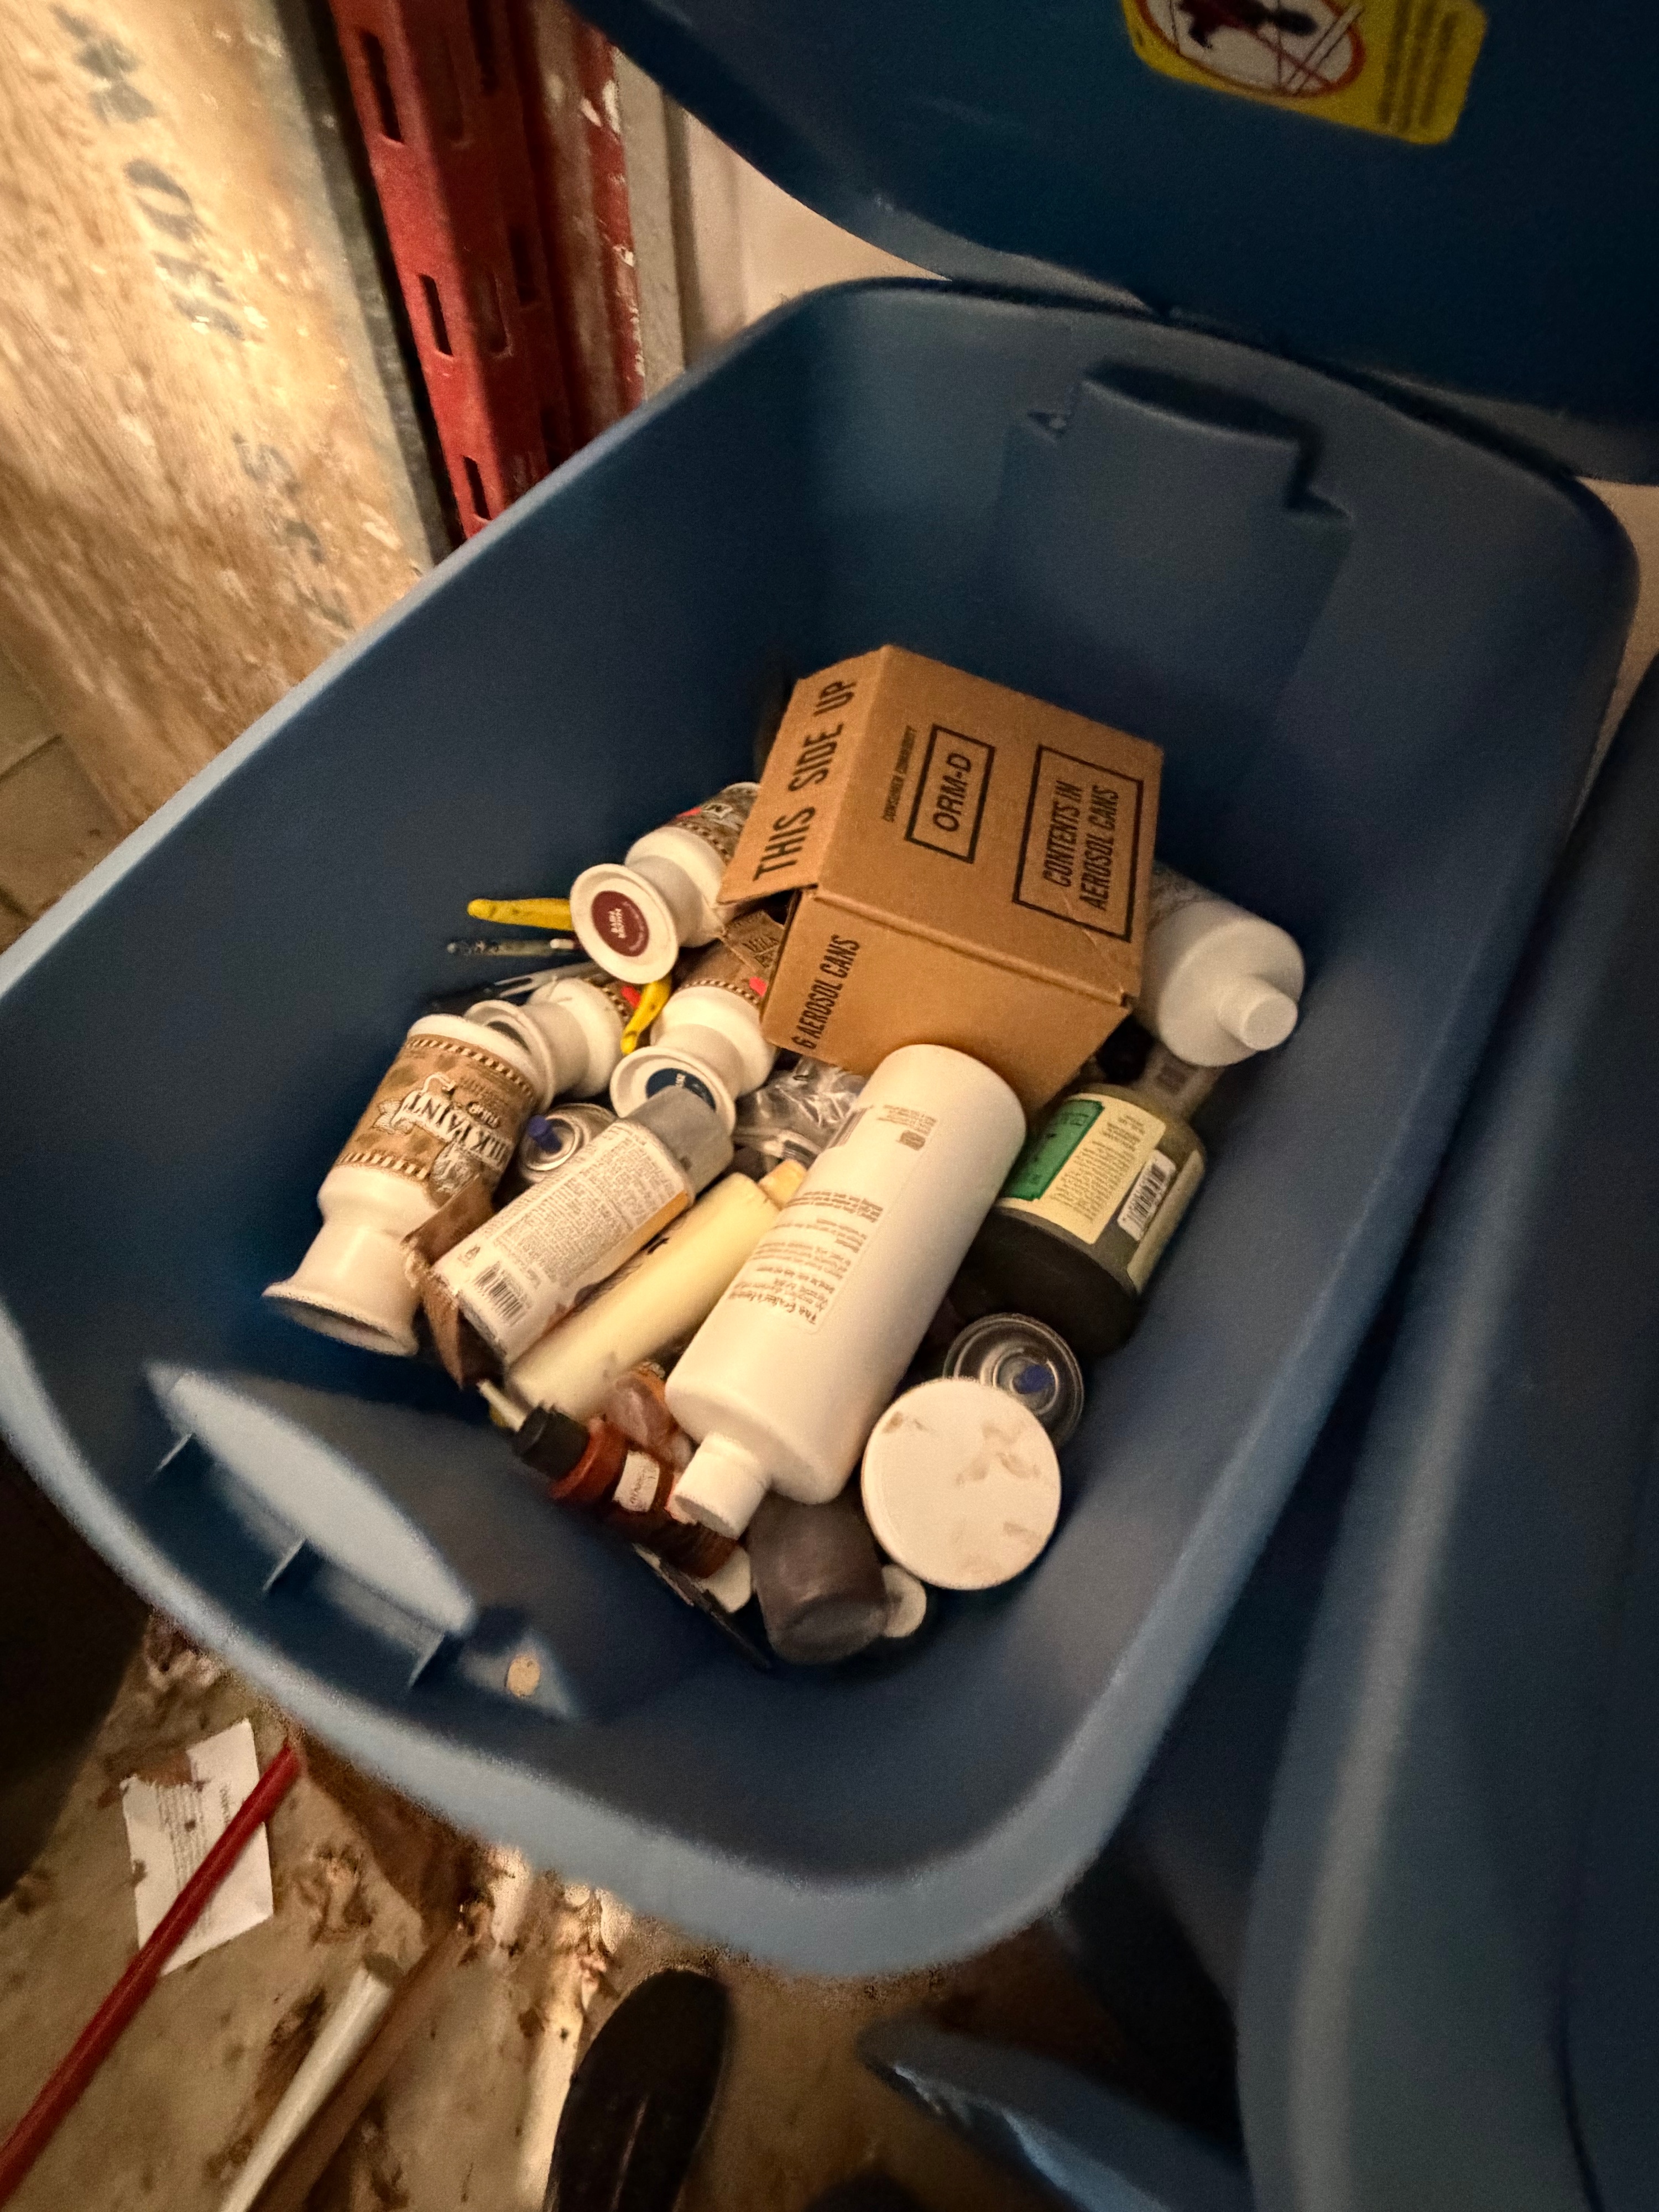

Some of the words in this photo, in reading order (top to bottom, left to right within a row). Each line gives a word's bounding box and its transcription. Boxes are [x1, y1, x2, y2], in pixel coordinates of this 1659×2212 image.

[813, 680, 857, 717] UP
[787, 722, 844, 792] SIDE
[932, 752, 972, 832] ORM-D
[1054, 780, 1082, 802] IN
[1087, 784, 1119, 831] CANS
[752, 806, 816, 881] THIS
[1042, 801, 1081, 888] CONTENTS
[1079, 833, 1114, 911] AEROSOL
[819, 933, 860, 979] CANS
[796, 978, 843, 1040] AEROSOL
[791, 1035, 817, 1049] 6
[402, 1093, 473, 1149] PAINT
